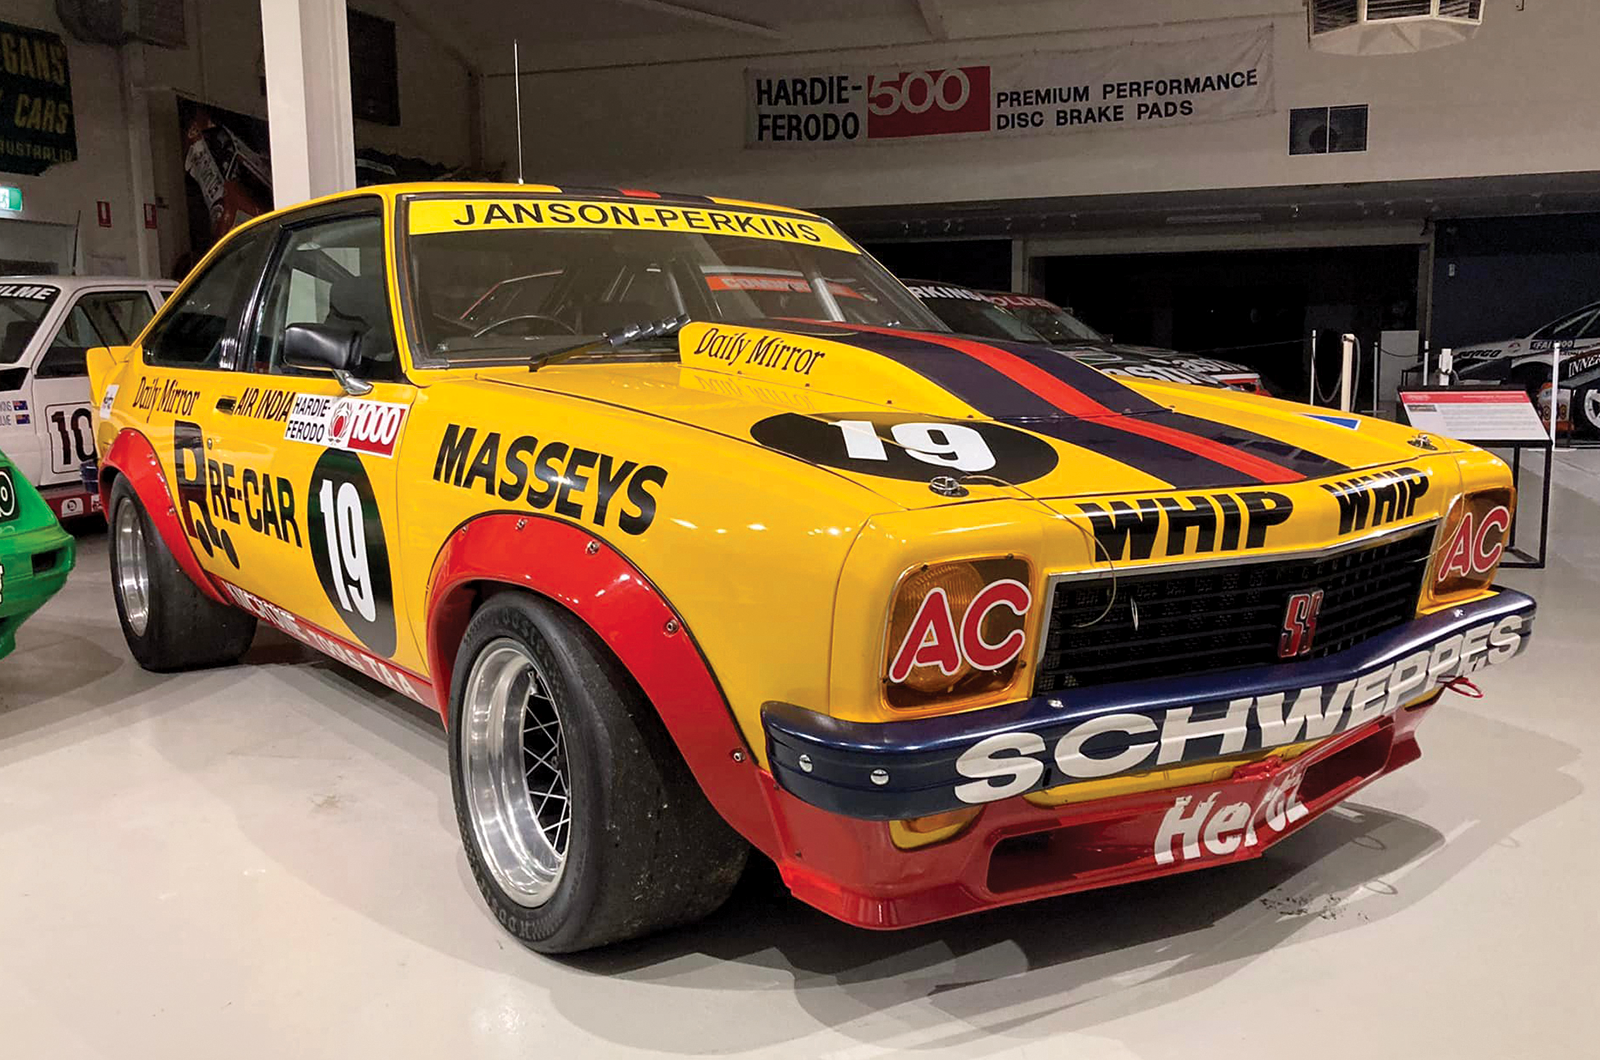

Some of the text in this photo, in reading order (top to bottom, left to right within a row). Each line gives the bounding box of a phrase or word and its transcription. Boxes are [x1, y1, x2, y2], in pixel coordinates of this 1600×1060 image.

[14, 92, 69, 134] CARS
[756, 68, 1258, 115] HARDIE- 500 PREMIUM PERFORMANCE
[757, 100, 1194, 141] FERODO DISC BRAKE PADS
[453, 202, 822, 242] JANSON-PERKINS
[693, 328, 825, 375] Daily Mirror
[132, 377, 161, 423] Daily
[158, 378, 200, 416] Mirror
[236, 387, 296, 422] AIR INDIA
[292, 396, 401, 445] HARDIE- 1000
[51, 408, 97, 465] 10
[287, 420, 326, 443] FERODO
[828, 420, 997, 472] 19
[208, 458, 303, 548] RE-CAR
[433, 423, 669, 535] MASSEYS
[1319, 467, 1430, 535] WHIP
[319, 479, 377, 622] 19
[1074, 491, 1294, 562] WHIP
[1438, 505, 1510, 582] AC
[889, 579, 1032, 683] AC
[360, 653, 424, 702] TAA
[954, 615, 1524, 804] SCHWEPPES
